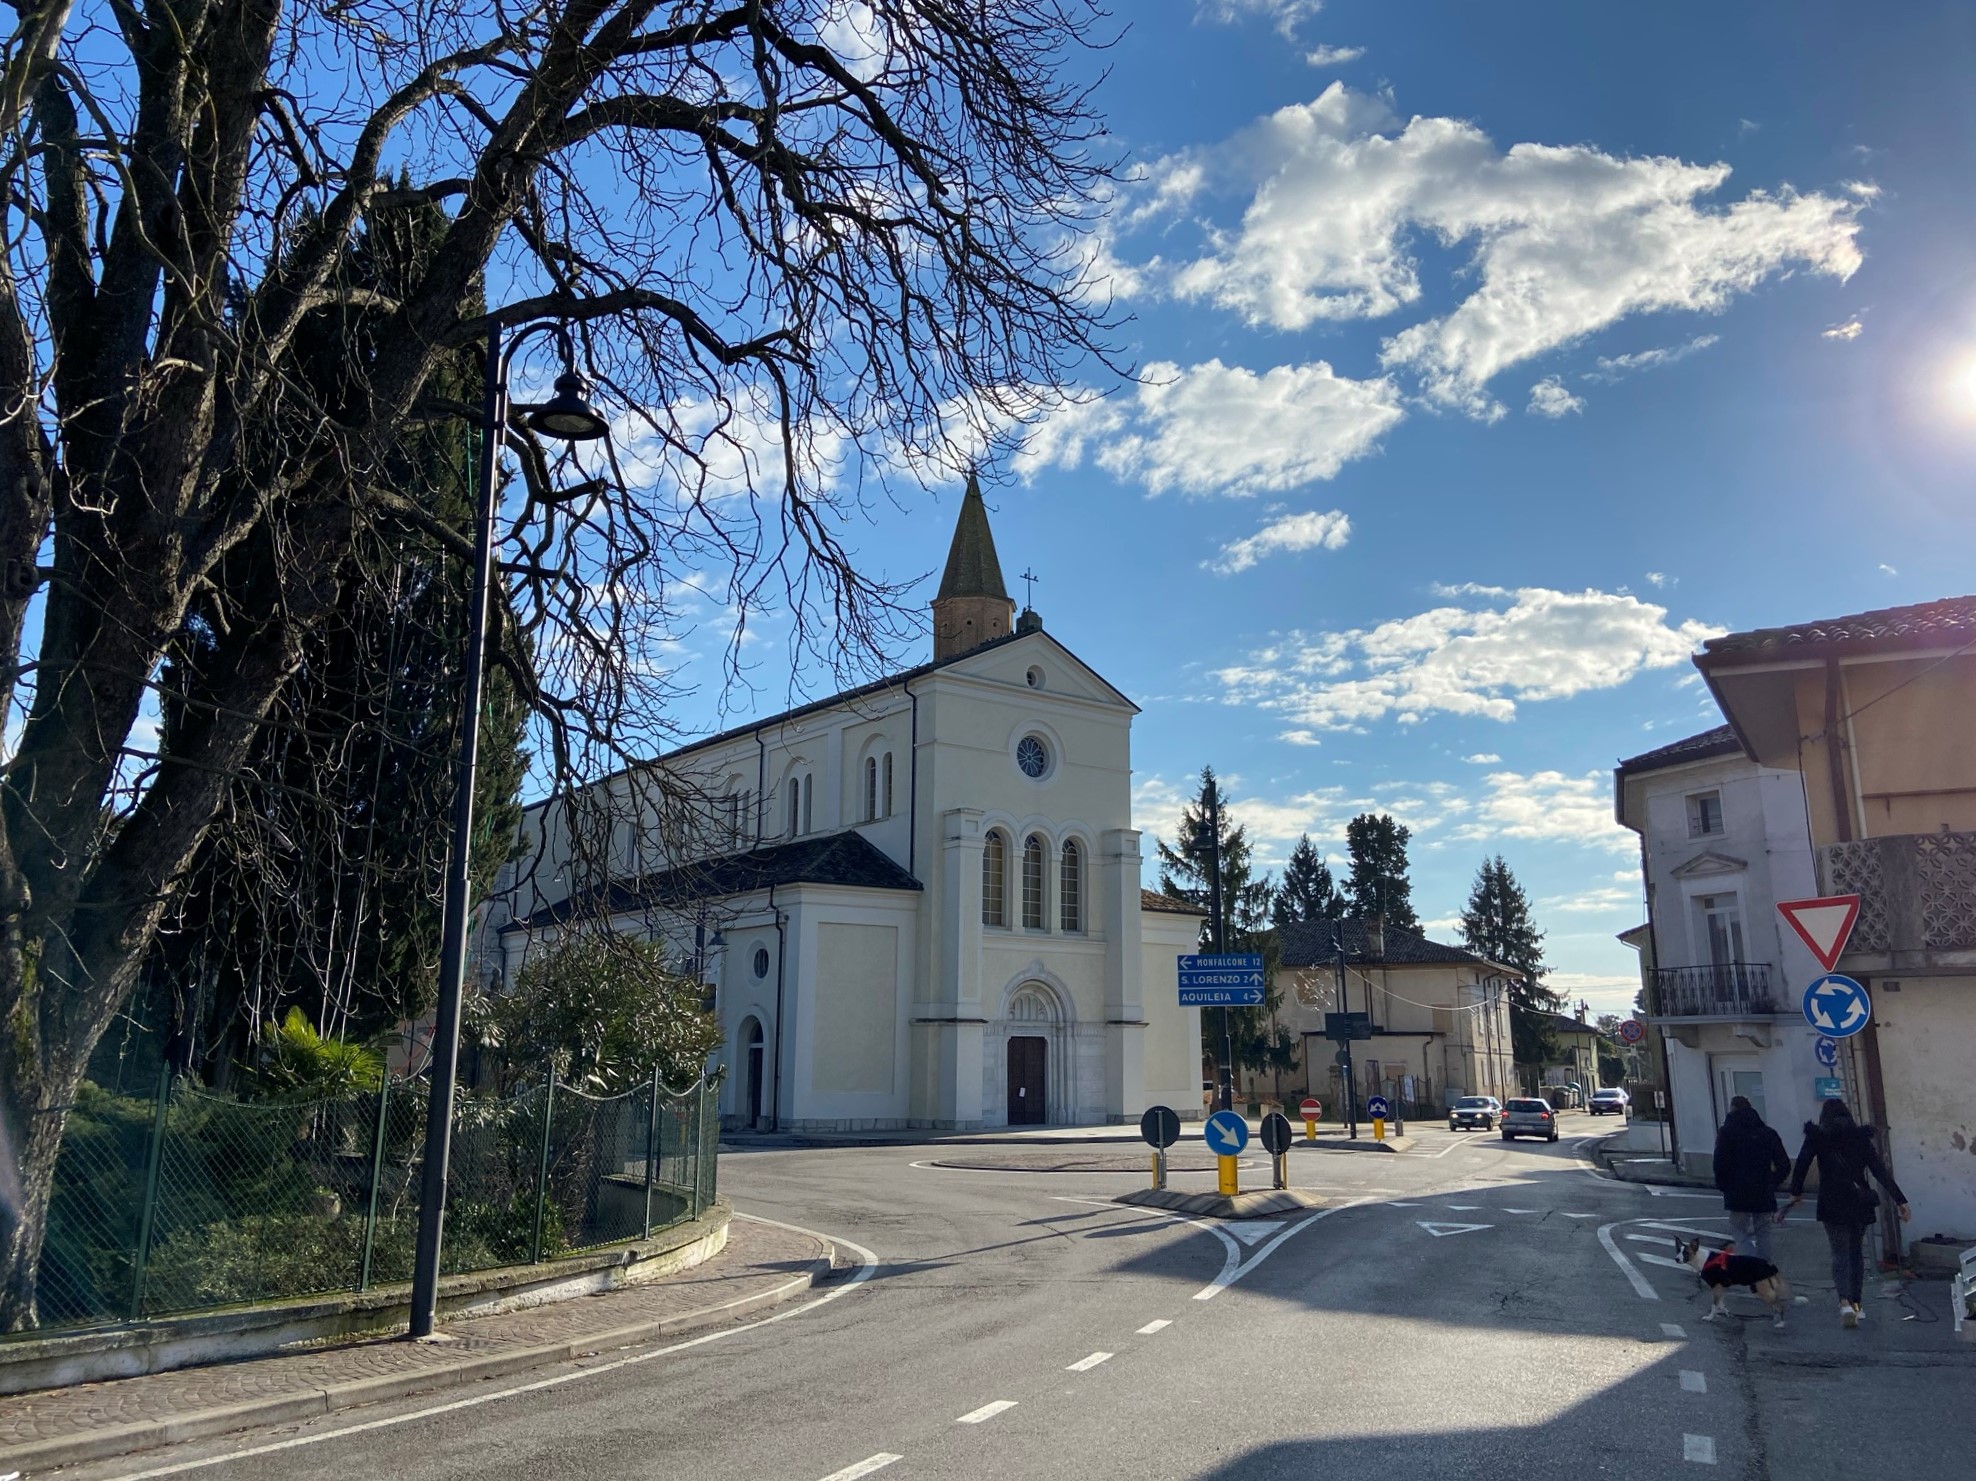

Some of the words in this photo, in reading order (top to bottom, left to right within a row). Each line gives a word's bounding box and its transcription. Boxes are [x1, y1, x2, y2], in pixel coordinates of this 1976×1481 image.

[1196, 958, 1247, 967] MONFALCONE
[1252, 958, 1261, 966] 12
[1181, 976, 1189, 985] S.
[1193, 975, 1240, 984] LORENZO
[1243, 975, 1248, 983] 2
[1181, 993, 1231, 1002] AQUILEIA
[1243, 993, 1248, 1001] 4
